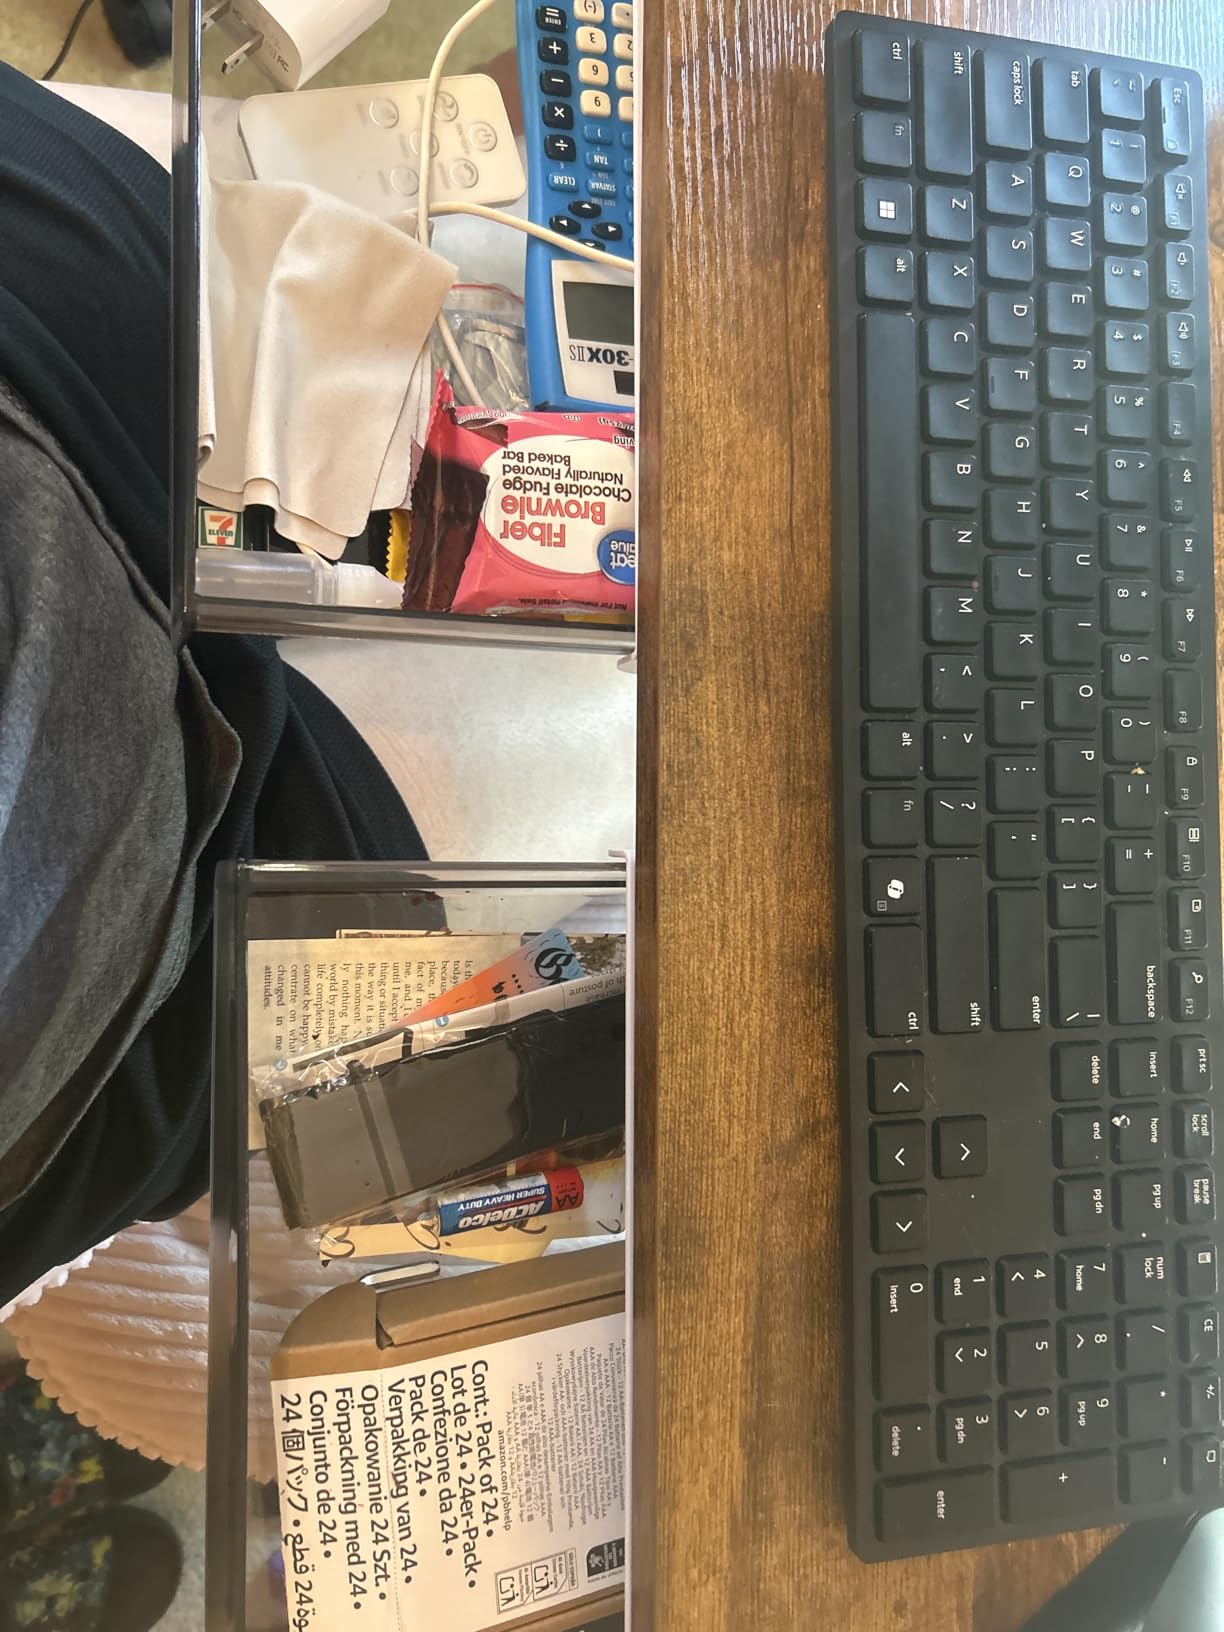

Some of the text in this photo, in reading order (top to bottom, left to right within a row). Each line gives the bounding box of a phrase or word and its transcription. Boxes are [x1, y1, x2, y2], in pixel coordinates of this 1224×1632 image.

[589, 32, 596, 44] 3
[893, 43, 902, 59] ctrl
[592, 64, 599, 76] 6
[954, 52, 963, 74] shift
[1012, 61, 1023, 104] caps lock
[1071, 71, 1080, 86] tab
[594, 96, 601, 107] 9
[593, 154, 609, 165] TAN
[553, 175, 576, 186] CLEAR
[1012, 175, 1024, 186] A
[1068, 166, 1082, 177] Q
[591, 181, 616, 192] STATVAR
[952, 199, 966, 209] Z
[1012, 240, 1025, 249] S
[1071, 231, 1083, 246] W
[897, 259, 906, 272] alt
[1072, 294, 1085, 304] E
[954, 332, 968, 342] C
[1114, 331, 1123, 339] 4
[1073, 360, 1085, 369] R
[1015, 370, 1028, 380] F
[1074, 425, 1087, 435] T
[502, 450, 571, 467] Baked Bar
[502, 463, 623, 485] Naturally Flavored
[957, 464, 970, 474] B
[502, 476, 632, 502] Chocolate Fudge
[1076, 490, 1088, 500] Y
[500, 494, 606, 525] Brownie
[1018, 502, 1030, 512] H
[499, 520, 566, 548] Fiber
[610, 540, 636, 554] alue
[610, 551, 636, 569] eat
[1118, 589, 1128, 597] 8
[959, 599, 972, 612] M
[1020, 634, 1033, 644] K
[1178, 641, 1185, 652] F7
[1120, 654, 1131, 662] 9
[902, 733, 912, 746] alt
[1081, 751, 1094, 760] P
[377, 962, 388, 998] thing or
[392, 962, 400, 983] until
[417, 961, 425, 992] fact of
[263, 965, 273, 1010] attitudes.
[326, 964, 338, 1007] world by
[354, 963, 363, 1024] this moment.
[569, 982, 603, 996] posture
[1146, 966, 1156, 1017] backspace
[275, 964, 286, 1051] changed in me
[299, 964, 313, 1047] cannot be happy.
[339, 979, 351, 1018] nothing
[389, 993, 399, 1022] accept
[288, 964, 298, 1055] centrate on what
[971, 1003, 980, 1026] shift
[1032, 996, 1041, 1023] enter
[909, 1012, 918, 1029] ctrl
[1092, 1056, 1100, 1083] delete
[1198, 1049, 1206, 1072] prt sc
[1093, 1122, 1101, 1139] end
[1201, 1115, 1209, 1135] scroll
[457, 1186, 546, 1212] SUPER HEAVY DUTY
[555, 1191, 579, 1209] AA
[1153, 1184, 1161, 1208] pg up
[1199, 1179, 1209, 1204] pause
[1093, 1189, 1103, 1213] pg dn
[458, 1200, 544, 1228] ACDelco
[1034, 1270, 1046, 1278] 4
[1094, 1263, 1105, 1271] 7
[1145, 1258, 1154, 1278] lock
[910, 1283, 923, 1292] 0
[954, 1278, 962, 1295] end
[1204, 1319, 1213, 1331] CE
[1037, 1407, 1049, 1415] 6
[1097, 1399, 1108, 1407] 9
[408, 1374, 433, 1484] Pack de 24
[976, 1416, 988, 1424] 3
[471, 1360, 499, 1525] Cont.: Pack of 24
[892, 1426, 900, 1456] delete
[280, 1393, 309, 1512] 24 個パック
[430, 1370, 459, 1544] Confezione da 24
[307, 1390, 338, 1545] Conjunto de 24
[385, 1378, 418, 1572] Verpakking van 24
[450, 1364, 482, 1576] Lot de 24 24er-Pack
[357, 1384, 392, 1588] Opakowanie 24 Szt.
[497, 1429, 512, 1531] amazon.com/pbhelp
[333, 1386, 367, 1597] Förpackning med 24
[937, 1491, 945, 1518] enter
[294, 1579, 314, 1606] 24
